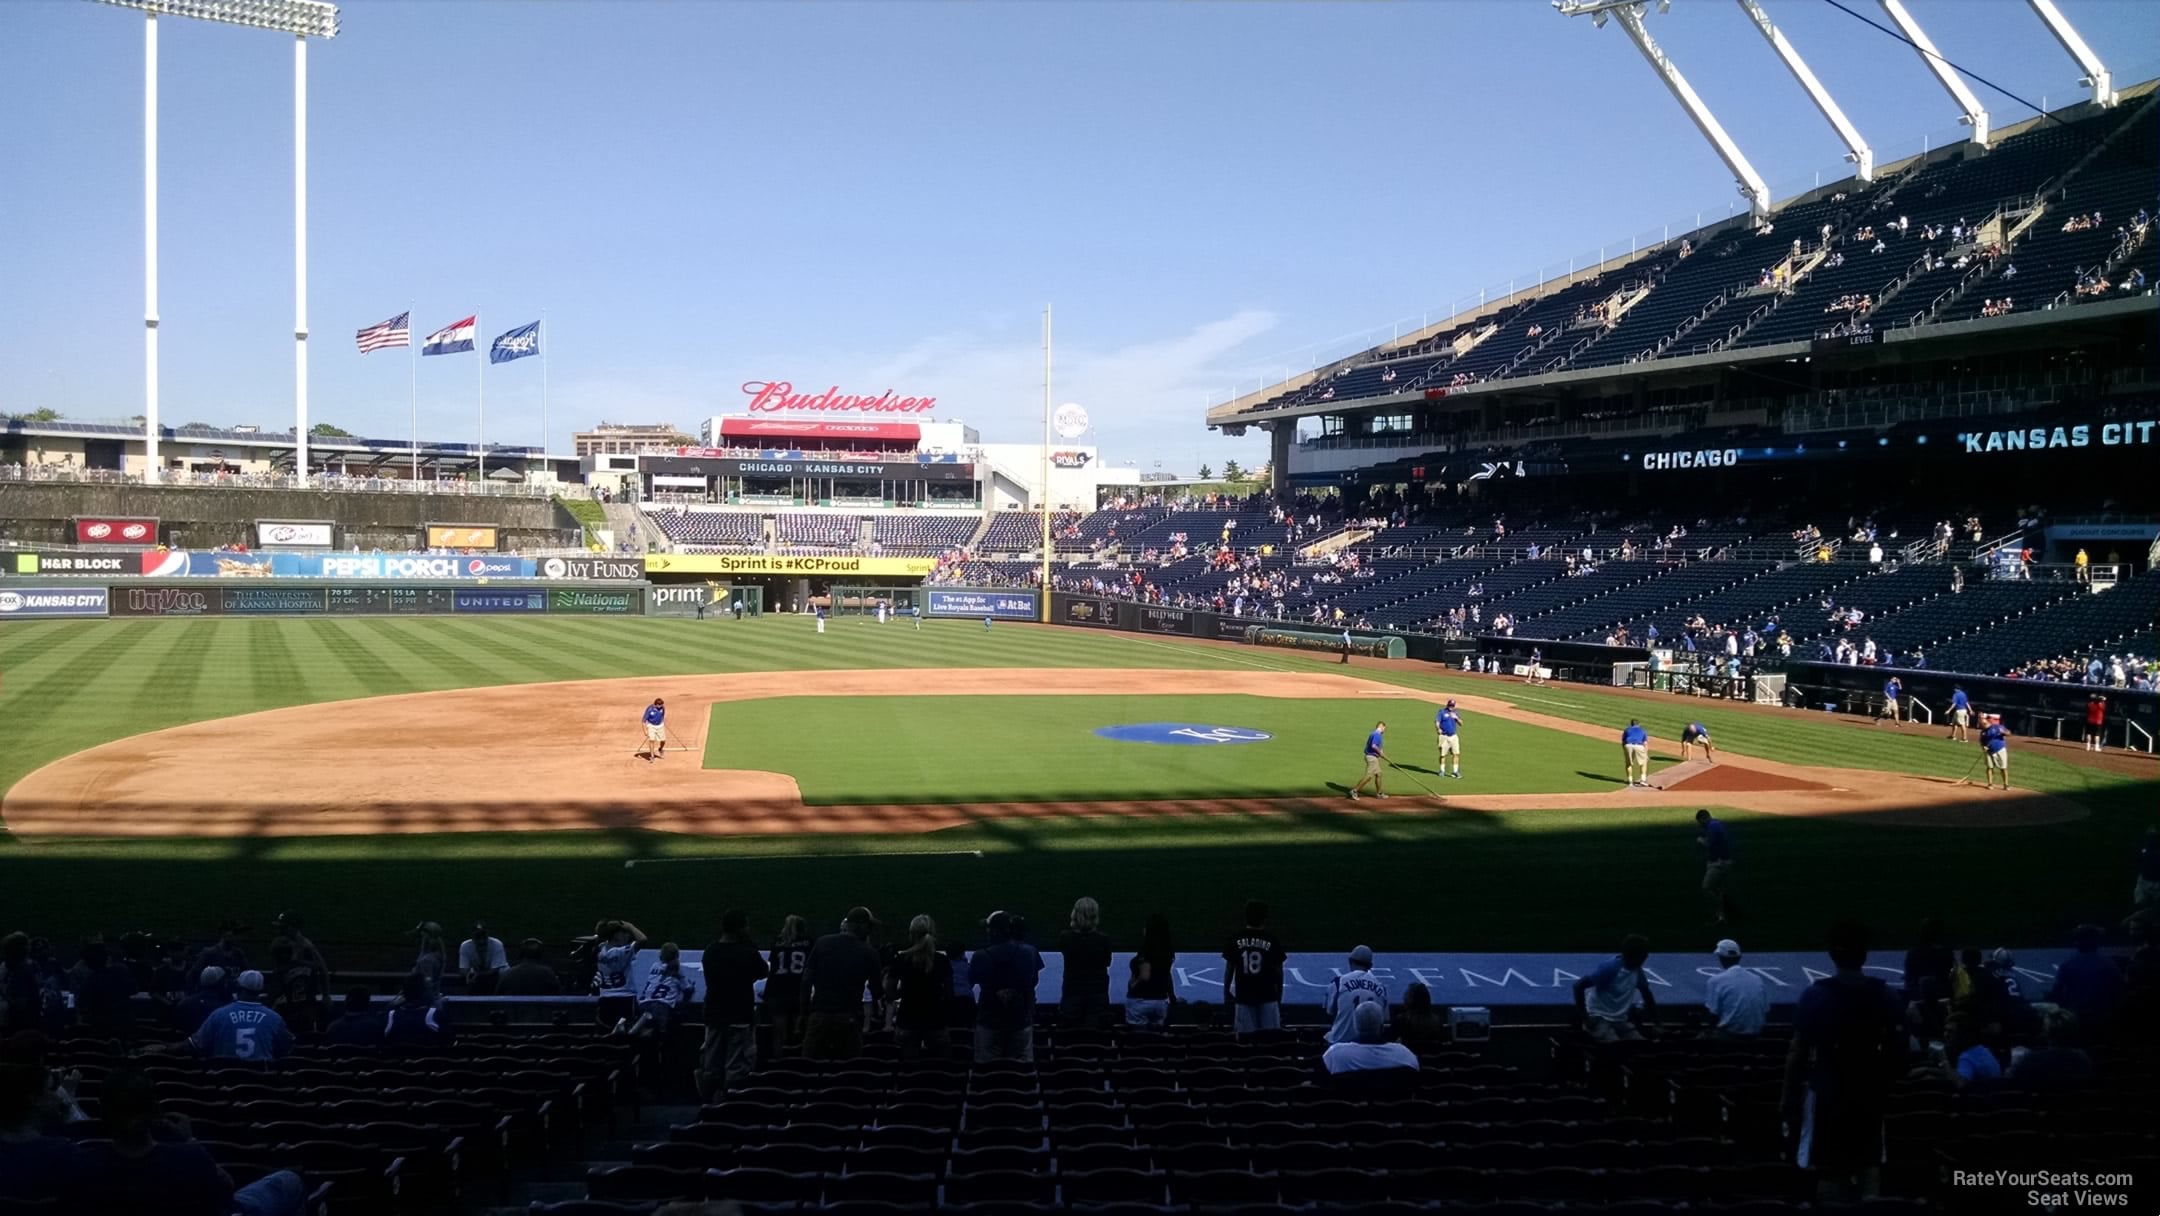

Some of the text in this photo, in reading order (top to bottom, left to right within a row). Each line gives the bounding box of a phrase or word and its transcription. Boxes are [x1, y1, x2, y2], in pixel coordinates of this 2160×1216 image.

[1850, 335, 1874, 345] LEVEL
[742, 381, 936, 412] Budweiser
[1966, 420, 2160, 452] KANSAS CIT
[1056, 456, 1085, 465] RIVALS
[1643, 449, 1737, 470] CHICAGO
[739, 463, 793, 472] CHICAGO
[806, 464, 854, 474] KANSAS
[857, 465, 884, 475] CITY
[41, 558, 122, 569] H&R BLOCK
[323, 559, 459, 576] PEPSI PORCH
[486, 563, 511, 572] pepsi
[567, 560, 639, 578] IVY FUNDS
[721, 557, 860, 571] Sprint is #KCProud
[906, 564, 931, 572] Sprint
[25, 595, 76, 607] KANSAS
[76, 595, 105, 607] CITY
[460, 598, 524, 606] UNITED
[574, 593, 630, 605] National
[963, 596, 976, 604] App
[1007, 600, 1032, 610] At Bat
[948, 604, 969, 612] Royals
[969, 604, 994, 612] Baseball
[1148, 609, 1184, 621] HOLLYWOOD
[775, 950, 807, 975] 18
[1241, 949, 1263, 975] 18
[1343, 979, 1384, 998] KONERKO
[229, 1010, 267, 1025] BRETT
[235, 1027, 256, 1058] 5
